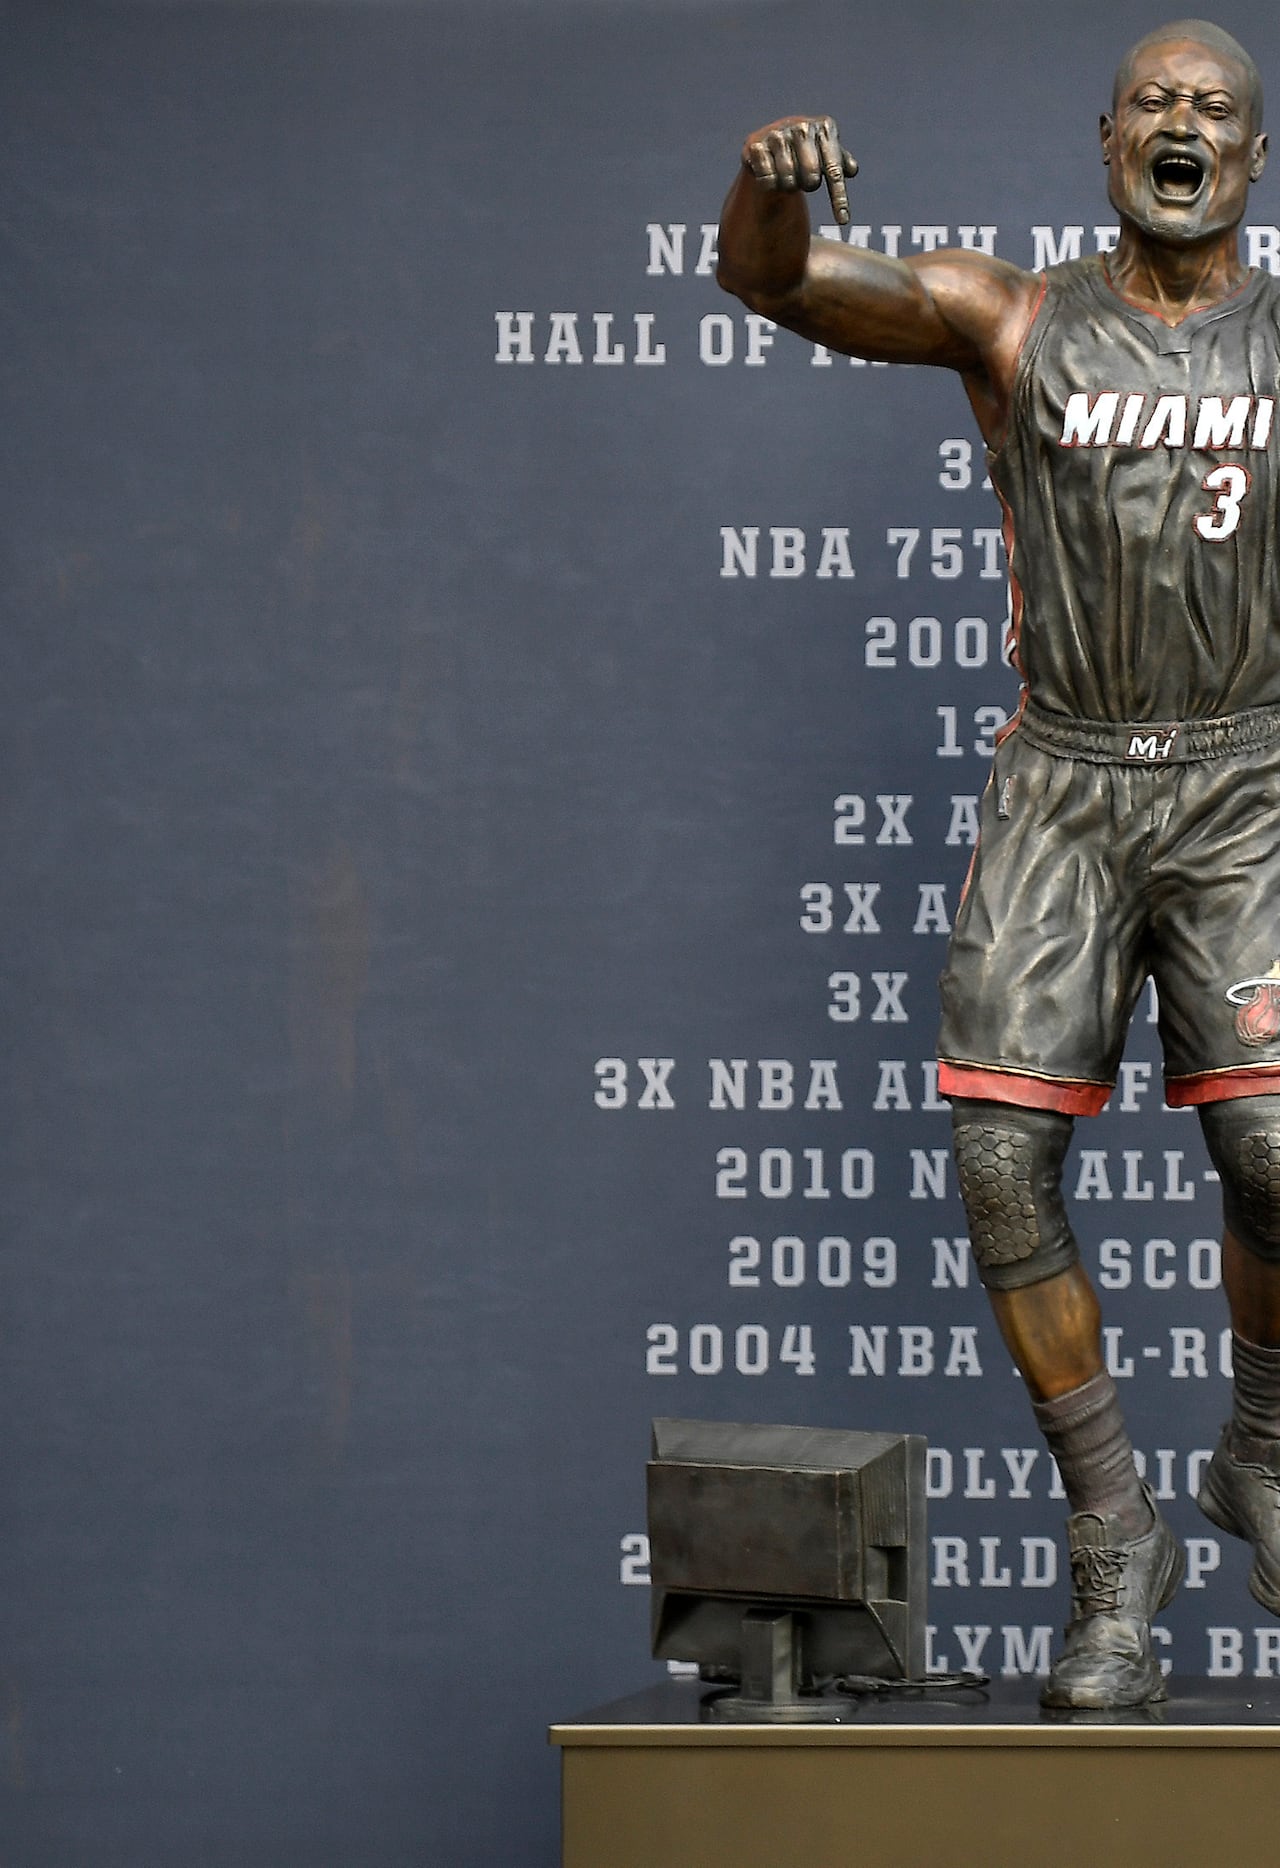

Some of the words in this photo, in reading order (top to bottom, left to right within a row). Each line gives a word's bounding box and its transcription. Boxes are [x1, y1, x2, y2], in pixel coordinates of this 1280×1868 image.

[495, 312, 667, 366] HALL
[700, 314, 778, 367] OF
[1059, 391, 1276, 450] MIAMI
[938, 438, 995, 490] 3
[1193, 463, 1252, 542] 3
[720, 527, 856, 579] NBA
[887, 528, 1006, 579] 75T
[866, 617, 1013, 668] 200
[937, 706, 1007, 756] 13
[835, 795, 913, 845] 2X
[800, 883, 881, 933] 3X
[829, 972, 908, 1022] 3X
[595, 1058, 676, 1110] 3X
[709, 1059, 843, 1110] NBA
[717, 1148, 874, 1199] 2010
[729, 1237, 897, 1288] 2009
[647, 1324, 816, 1375] 2004
[850, 1326, 983, 1376] NBA
[932, 1537, 1057, 1587] RLD
